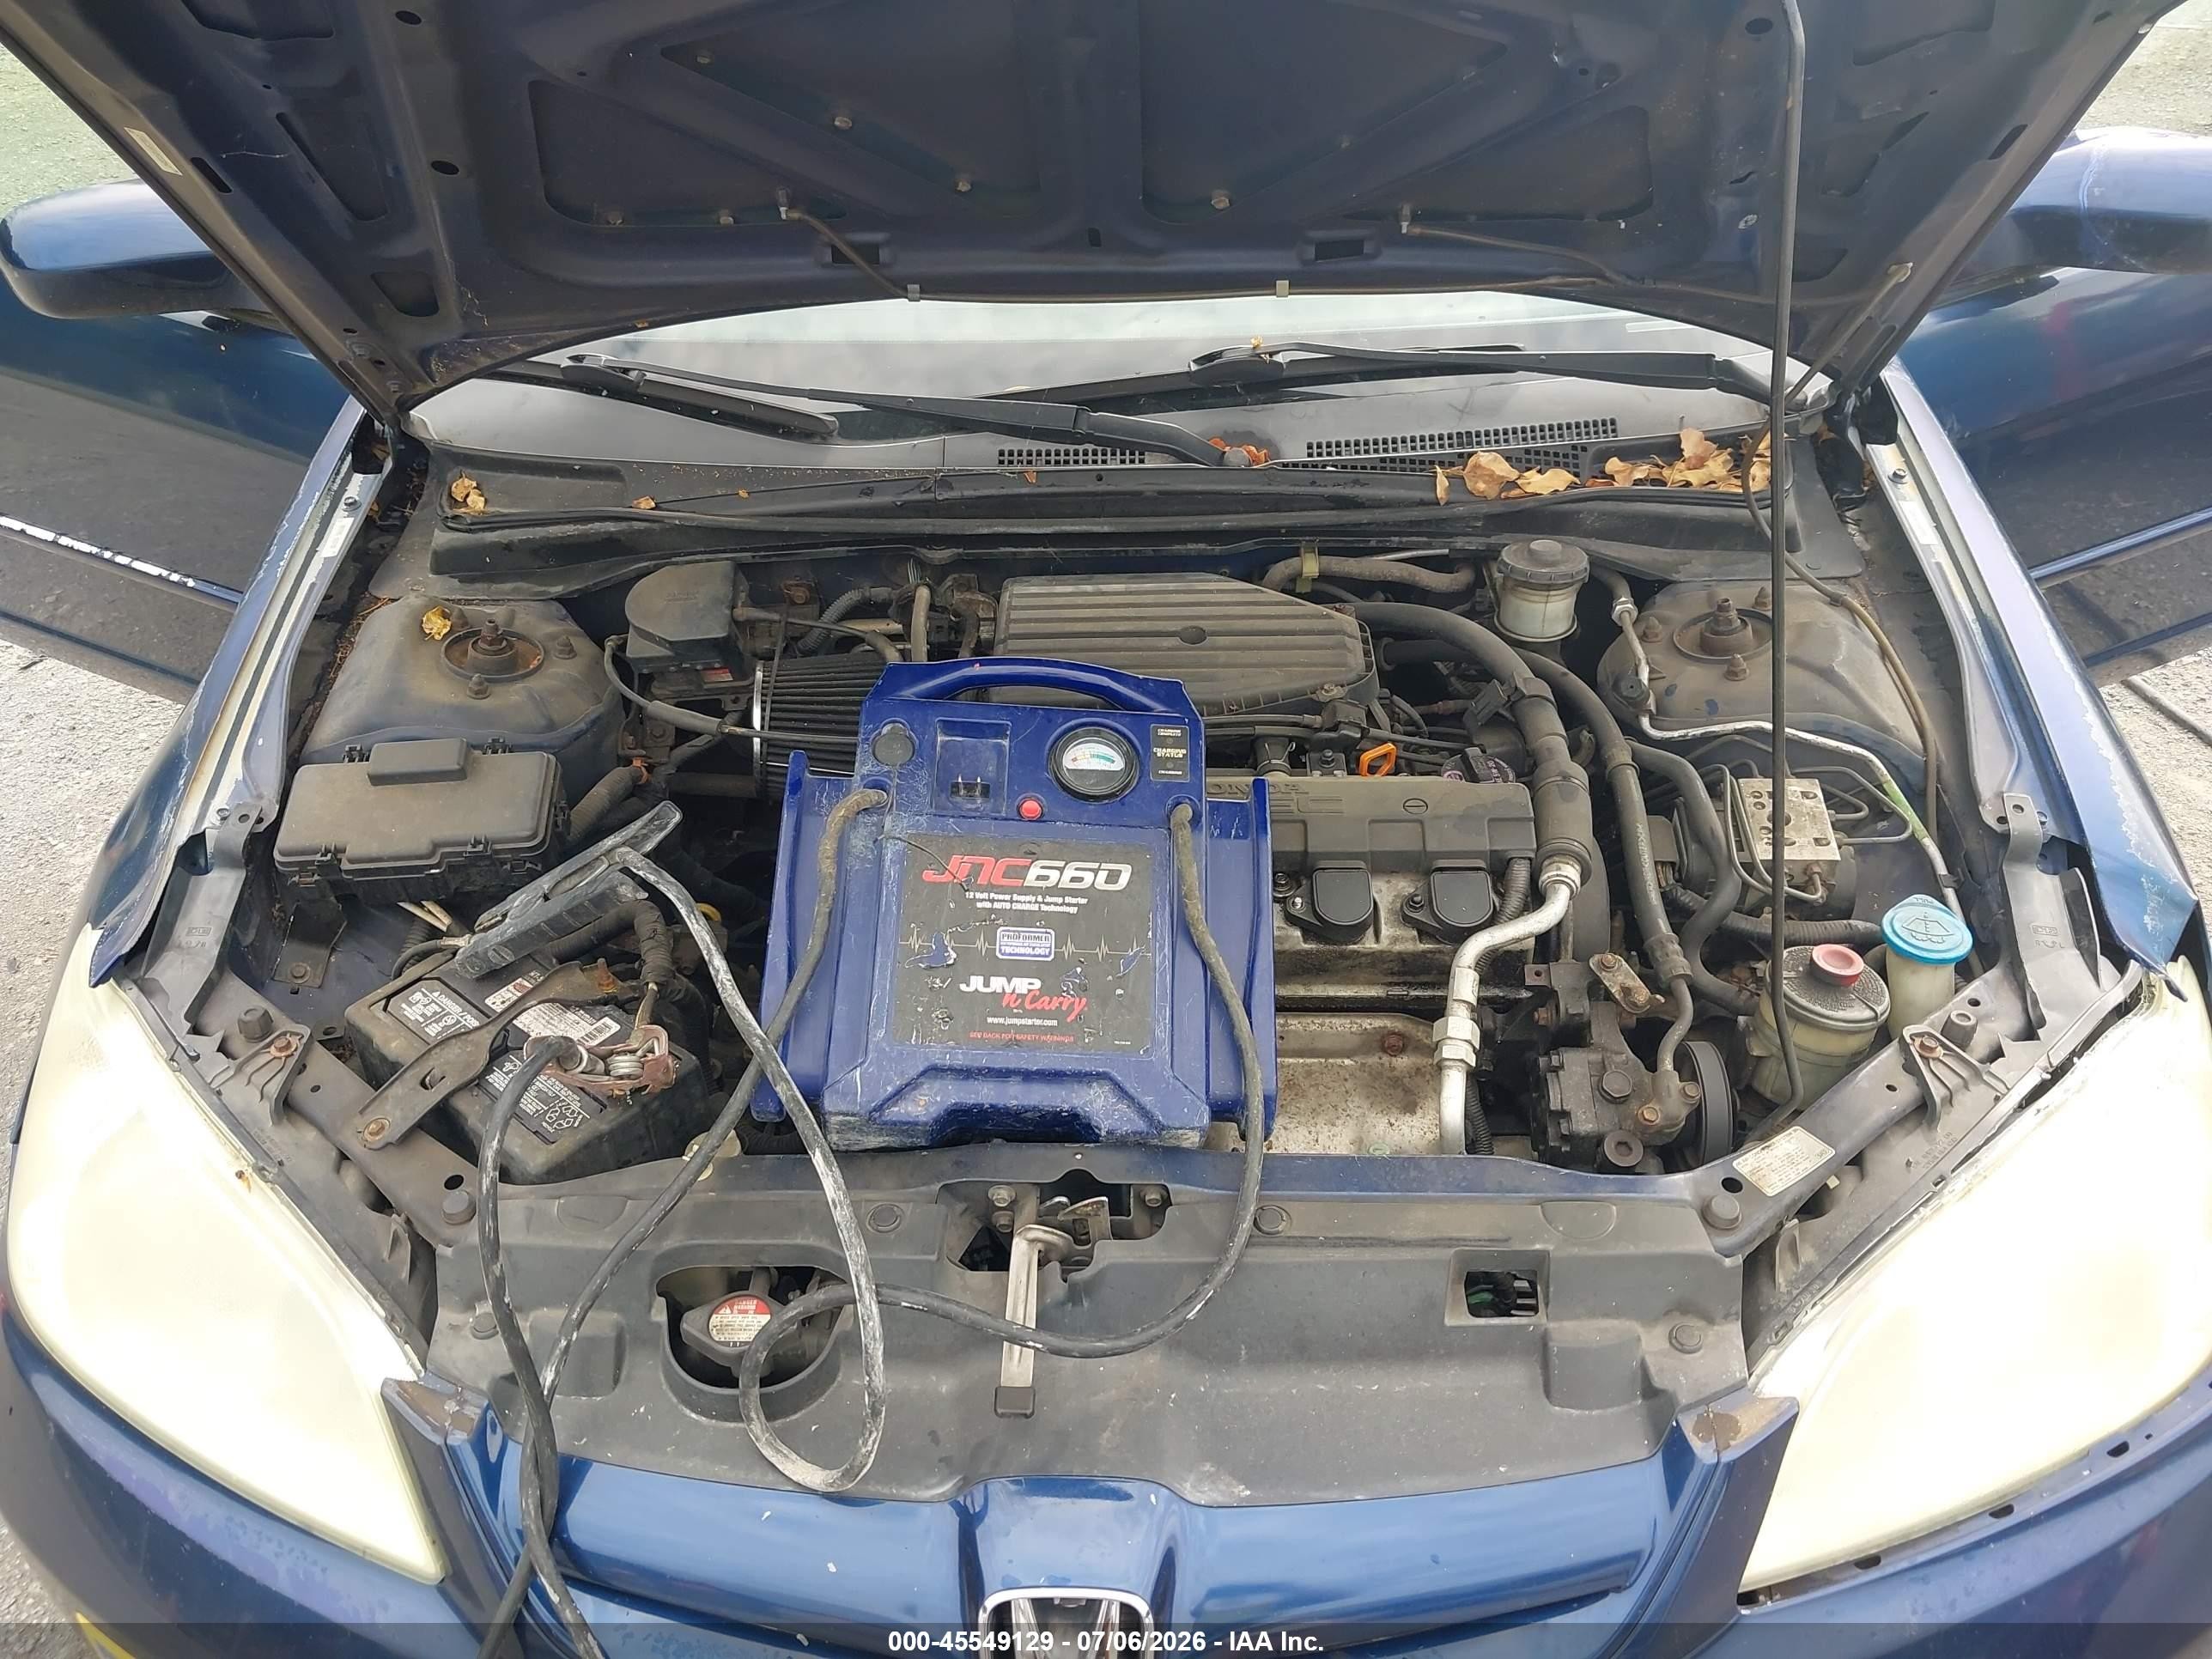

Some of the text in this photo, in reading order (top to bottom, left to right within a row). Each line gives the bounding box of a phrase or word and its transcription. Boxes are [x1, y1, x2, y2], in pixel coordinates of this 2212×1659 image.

[921, 854, 1133, 891] JNC660
[1012, 894, 1036, 903] Supply
[1044, 895, 1063, 904] Jump
[1064, 896, 1088, 905] Starter
[1012, 902, 1039, 911] CHARGE
[1040, 903, 1078, 915] Technology
[1000, 945, 1050, 956] TECHNOLOGY
[959, 975, 1042, 994] JUMP
[438, 994, 462, 1013] DANGER
[464, 1014, 480, 1027] POIS
[1002, 989, 1087, 1023] n Carry
[987, 1016, 1058, 1027] www.jumpstarter.com
